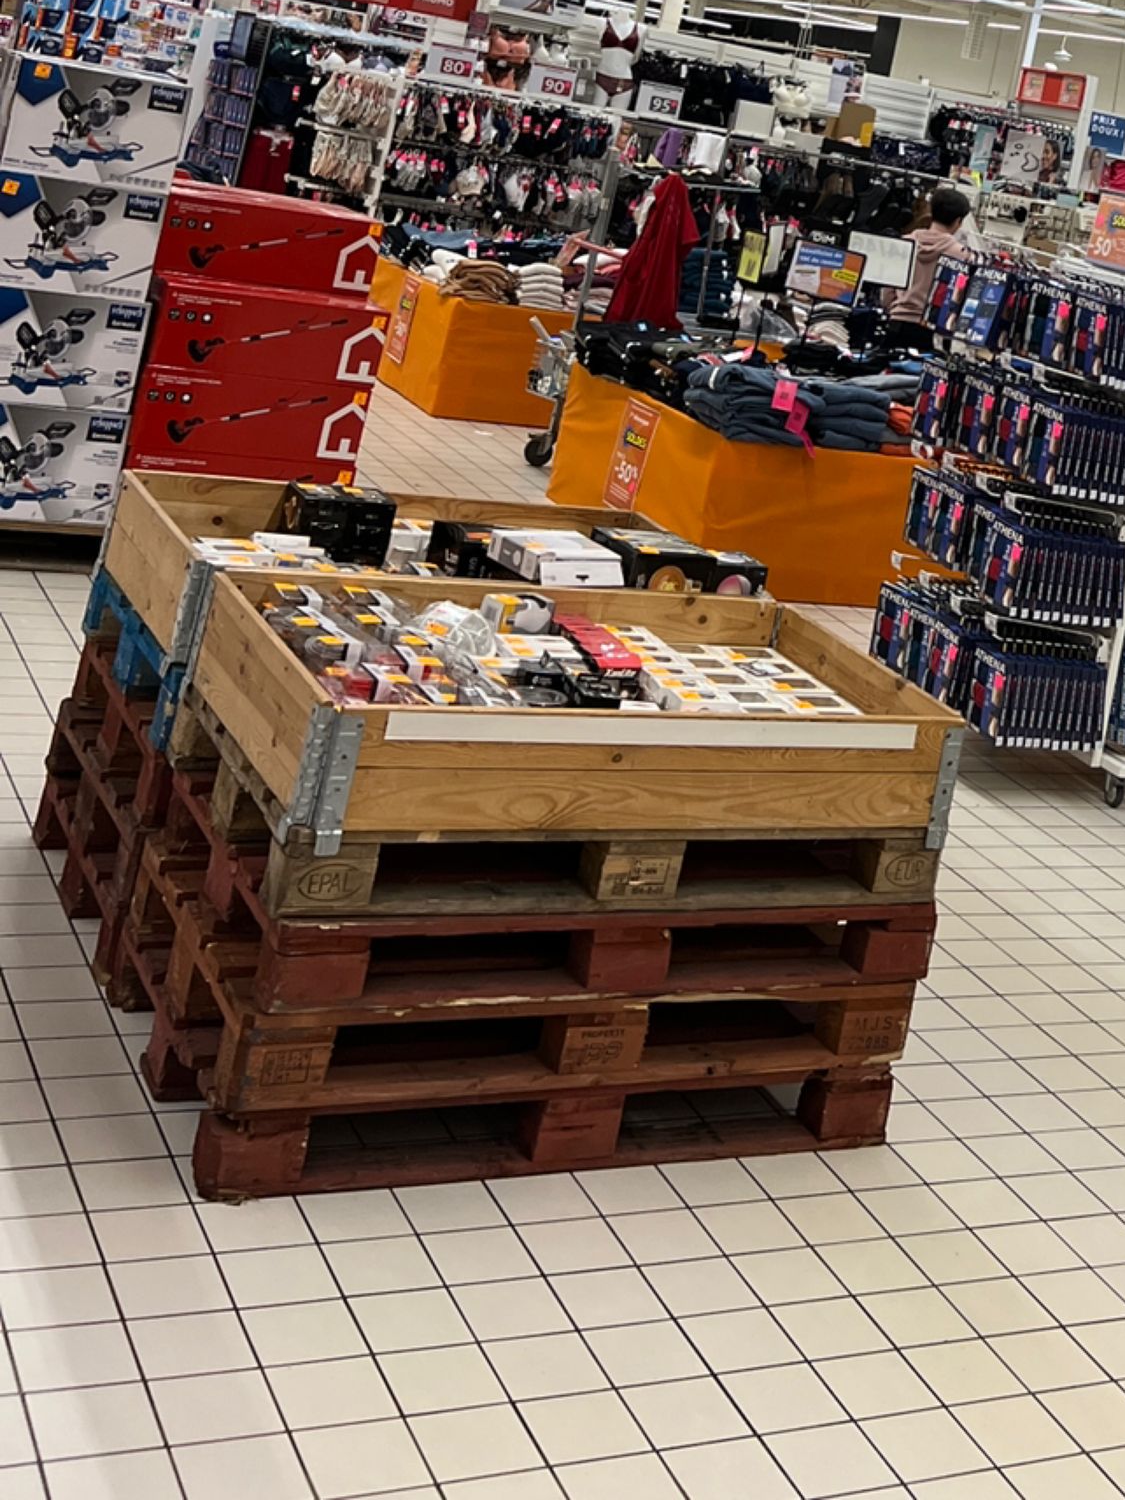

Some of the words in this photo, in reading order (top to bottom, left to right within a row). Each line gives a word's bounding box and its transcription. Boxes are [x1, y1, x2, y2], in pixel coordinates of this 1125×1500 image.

[443, 58, 464, 75] 80
[544, 78, 566, 95] 90
[651, 96, 671, 112] 95
[1092, 114, 1117, 127] PRIX
[1030, 282, 1072, 302] ATHENA
[1076, 296, 1107, 315] ATHENA
[964, 374, 995, 394] ATHENA
[1002, 386, 1031, 404] ATHENA
[1032, 402, 1065, 422] ATHENA
[937, 480, 965, 504] ATHENA
[993, 521, 1026, 546] ATHENA
[975, 647, 1006, 672] ATHENA
[306, 872, 352, 895] EPAL
